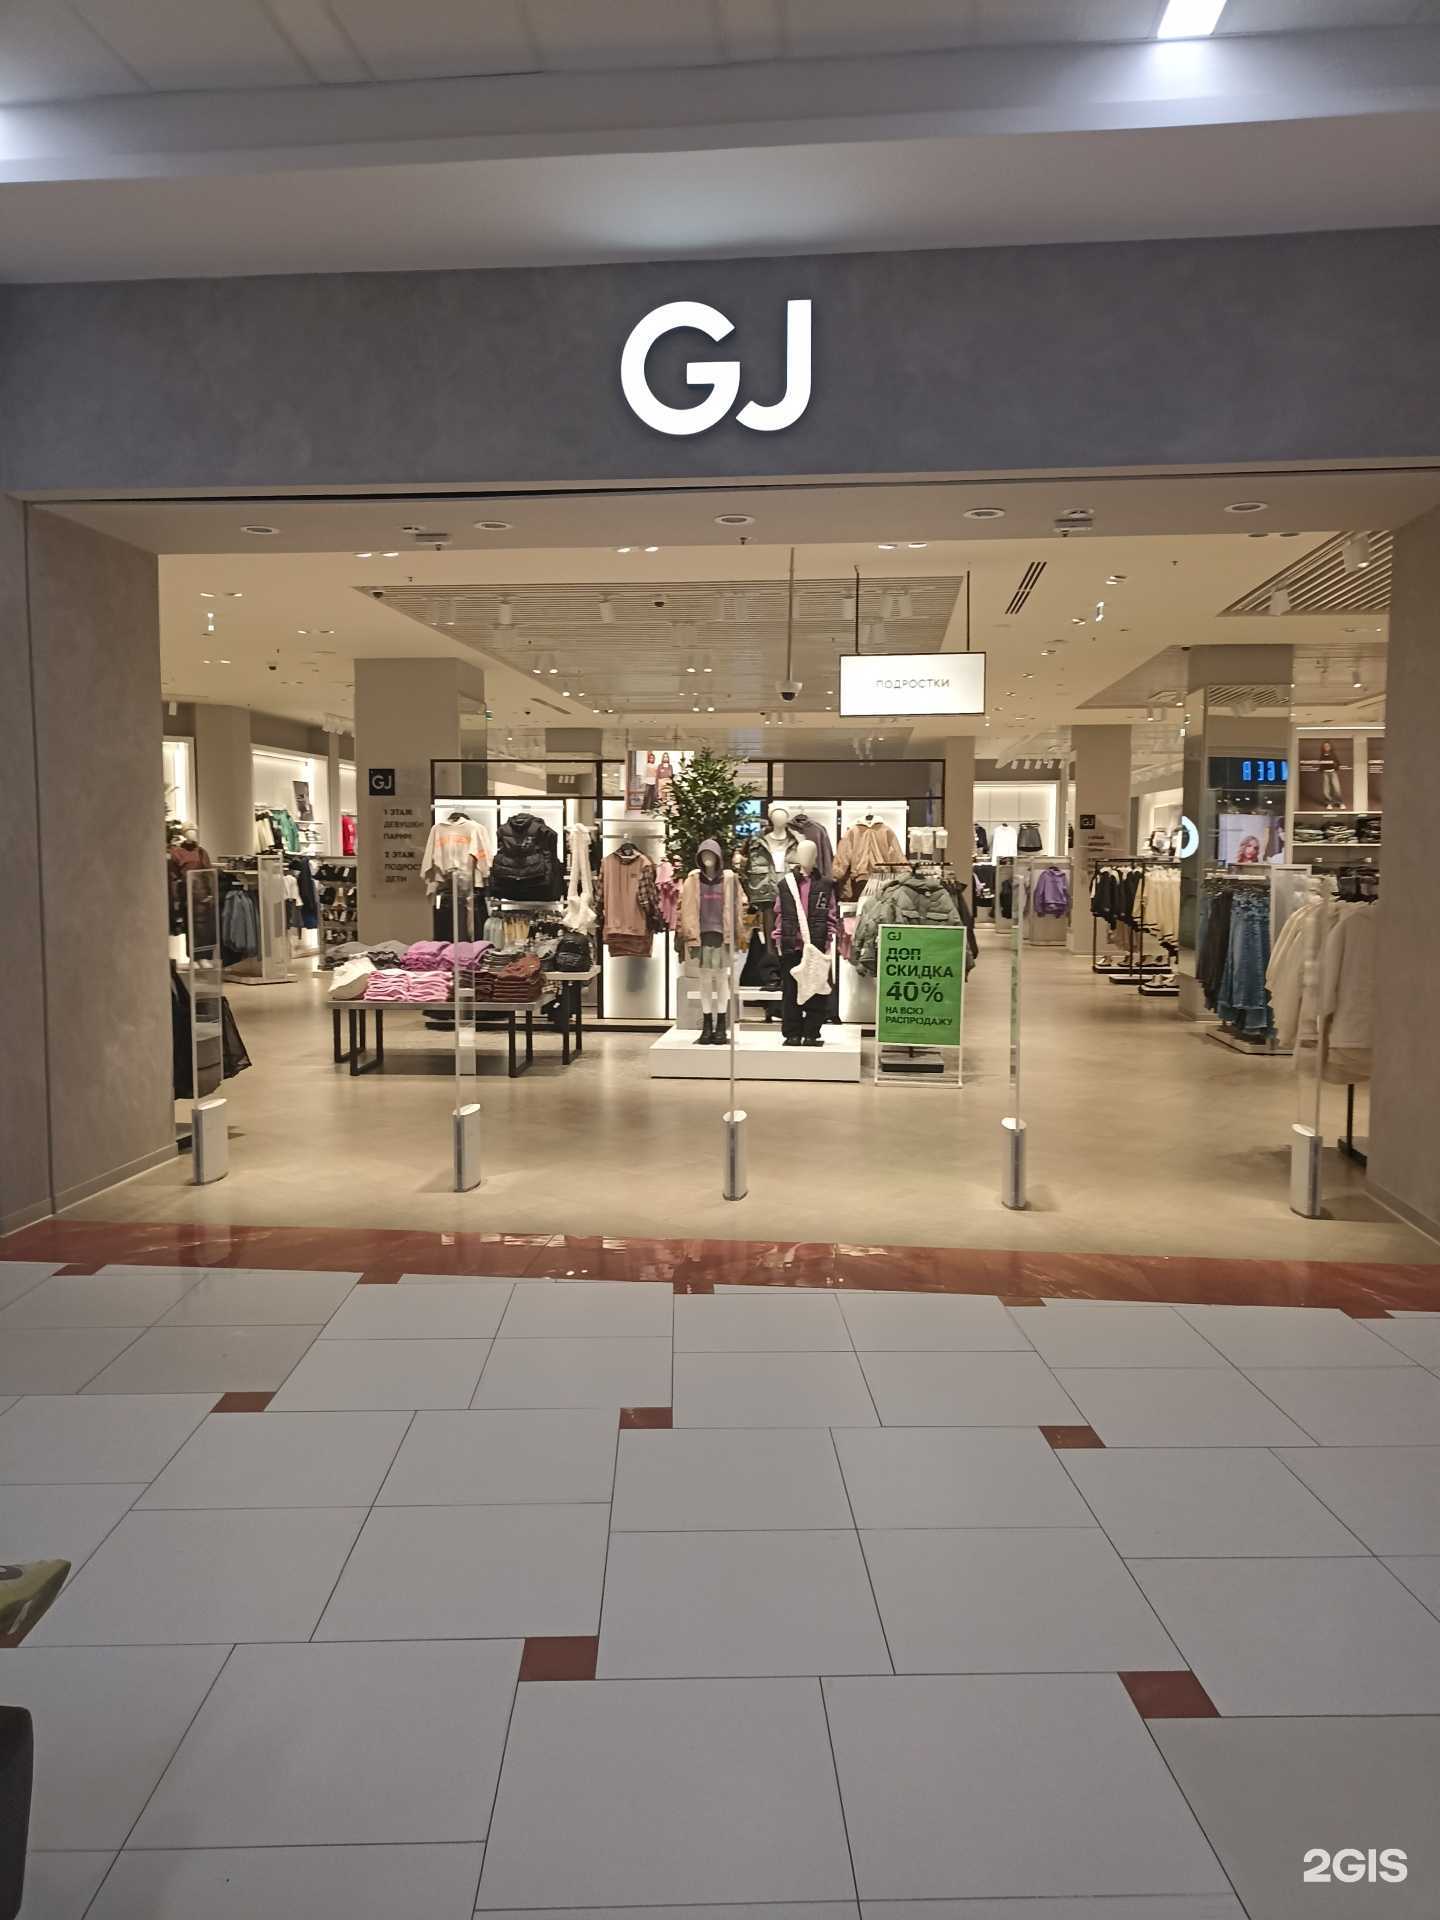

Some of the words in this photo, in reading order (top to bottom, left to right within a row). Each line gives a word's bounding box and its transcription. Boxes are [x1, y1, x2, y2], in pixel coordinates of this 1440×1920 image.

[620, 299, 812, 436] GJ
[875, 679, 950, 689] ПОДРОСТКИ
[372, 775, 392, 789] GJ
[887, 931, 902, 941] GJ
[886, 947, 921, 962] ДОП
[886, 964, 954, 979] СКИДКА
[886, 981, 944, 1003] 40%
[885, 1006, 898, 1015] НА
[900, 1006, 924, 1015] ВСЮ
[885, 1016, 953, 1026] РАСПРОДАЖУ
